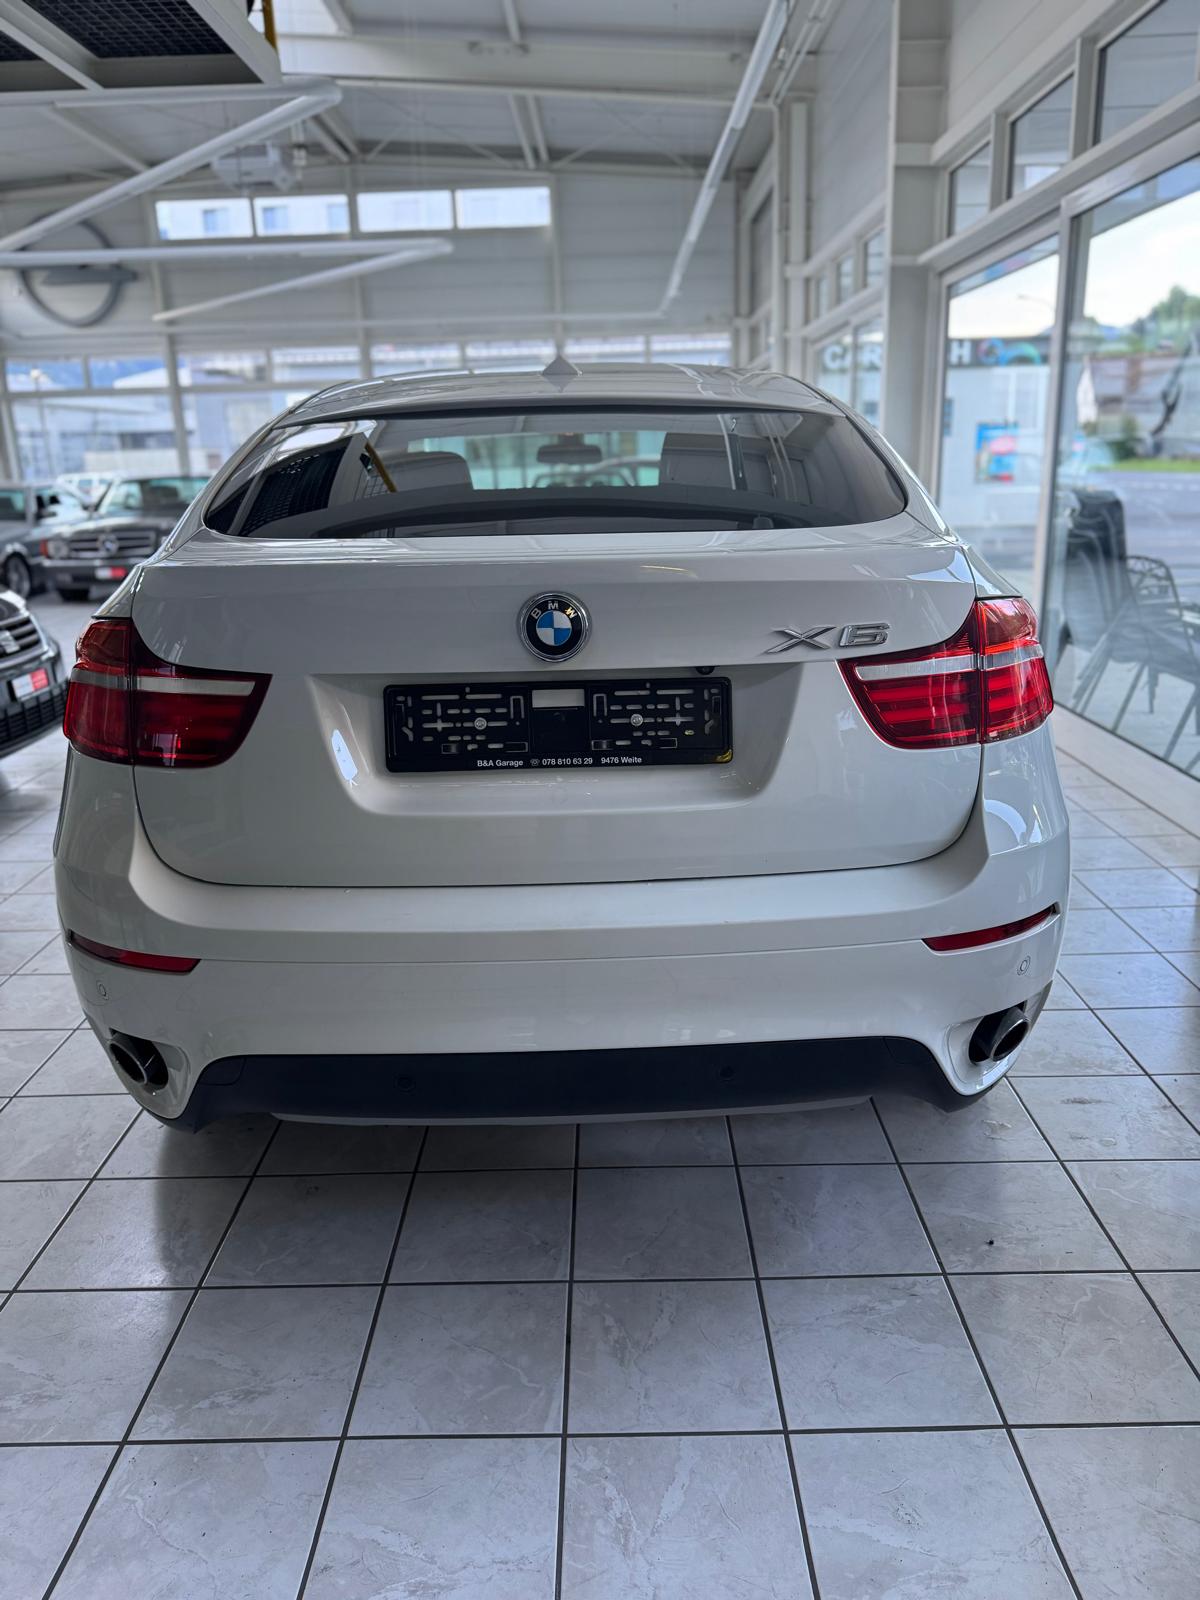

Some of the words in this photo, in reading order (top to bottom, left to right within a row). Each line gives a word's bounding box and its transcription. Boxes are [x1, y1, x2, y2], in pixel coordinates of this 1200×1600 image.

[530, 600, 578, 620] BMW
[764, 622, 890, 654] X6
[477, 759, 494, 767] B&A
[495, 759, 524, 768] Garage
[541, 758, 556, 766] 078
[572, 757, 582, 765] 63
[583, 757, 593, 765] 29
[600, 756, 619, 764] 9476
[620, 756, 642, 764] Weite
